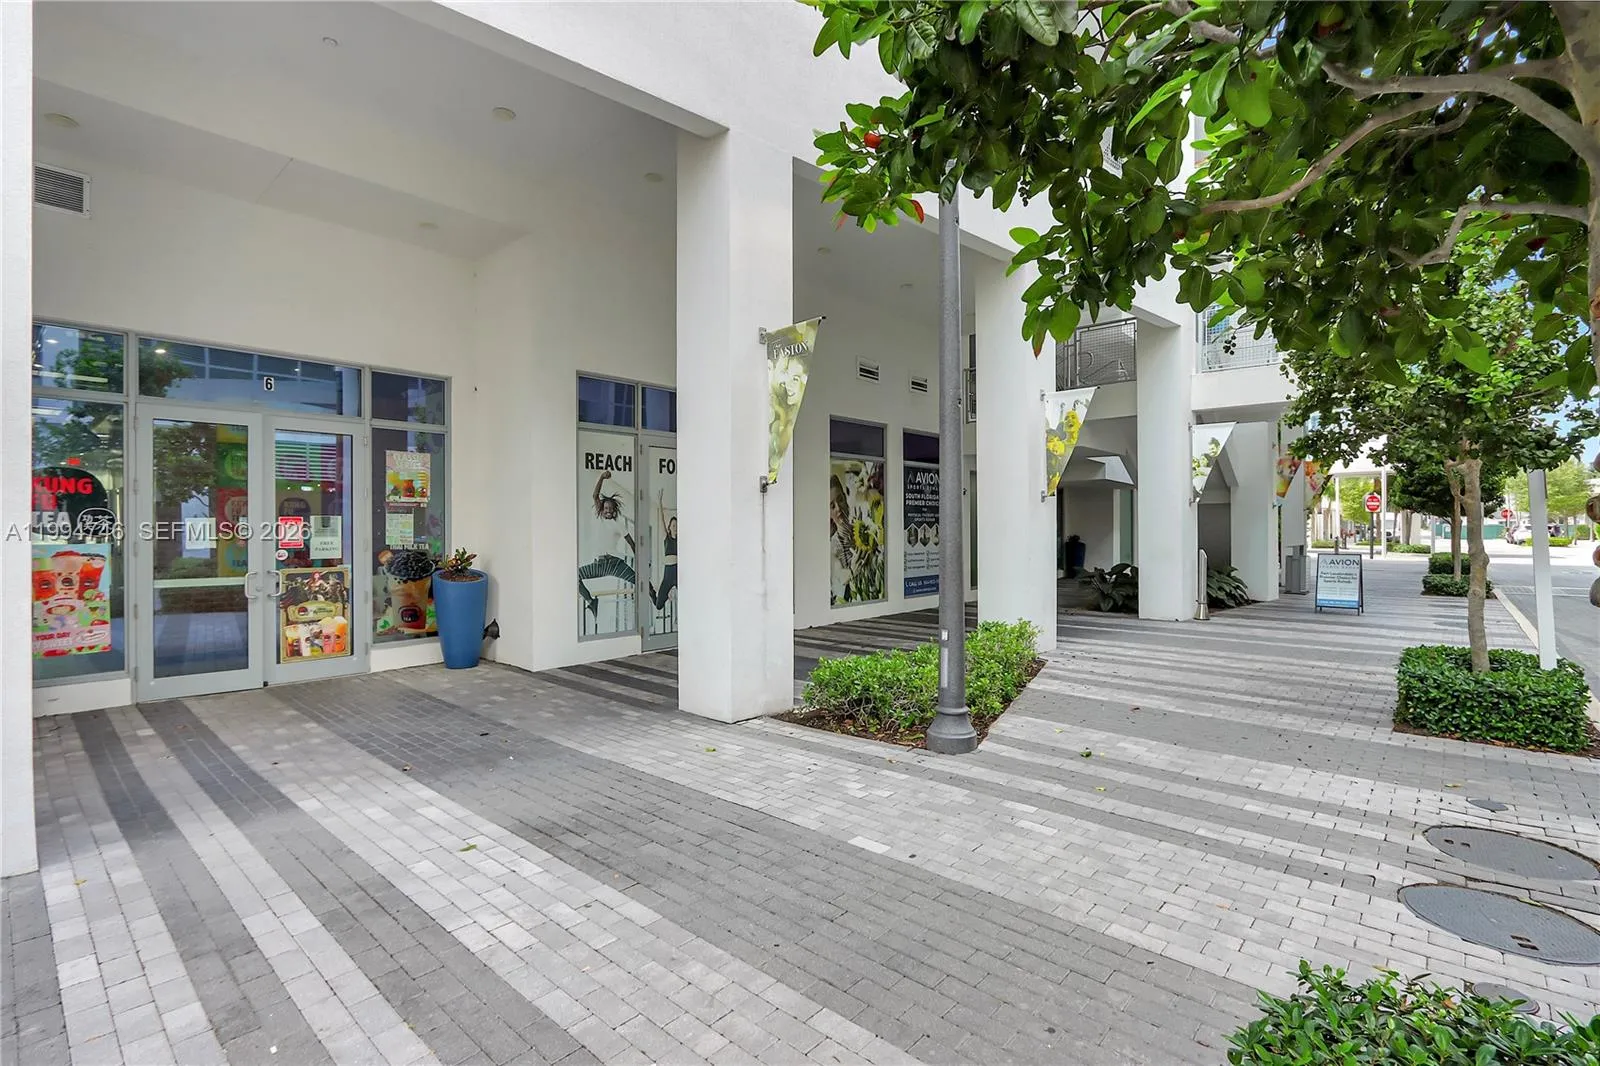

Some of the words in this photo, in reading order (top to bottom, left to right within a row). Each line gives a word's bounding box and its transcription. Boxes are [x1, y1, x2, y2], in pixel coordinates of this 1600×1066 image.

[265, 377, 273, 391] 6
[584, 452, 633, 472] REACH
[658, 458, 676, 475] FO
[32, 476, 93, 495] KUNG
[915, 471, 940, 485] AVION
[32, 511, 71, 529] TEA
